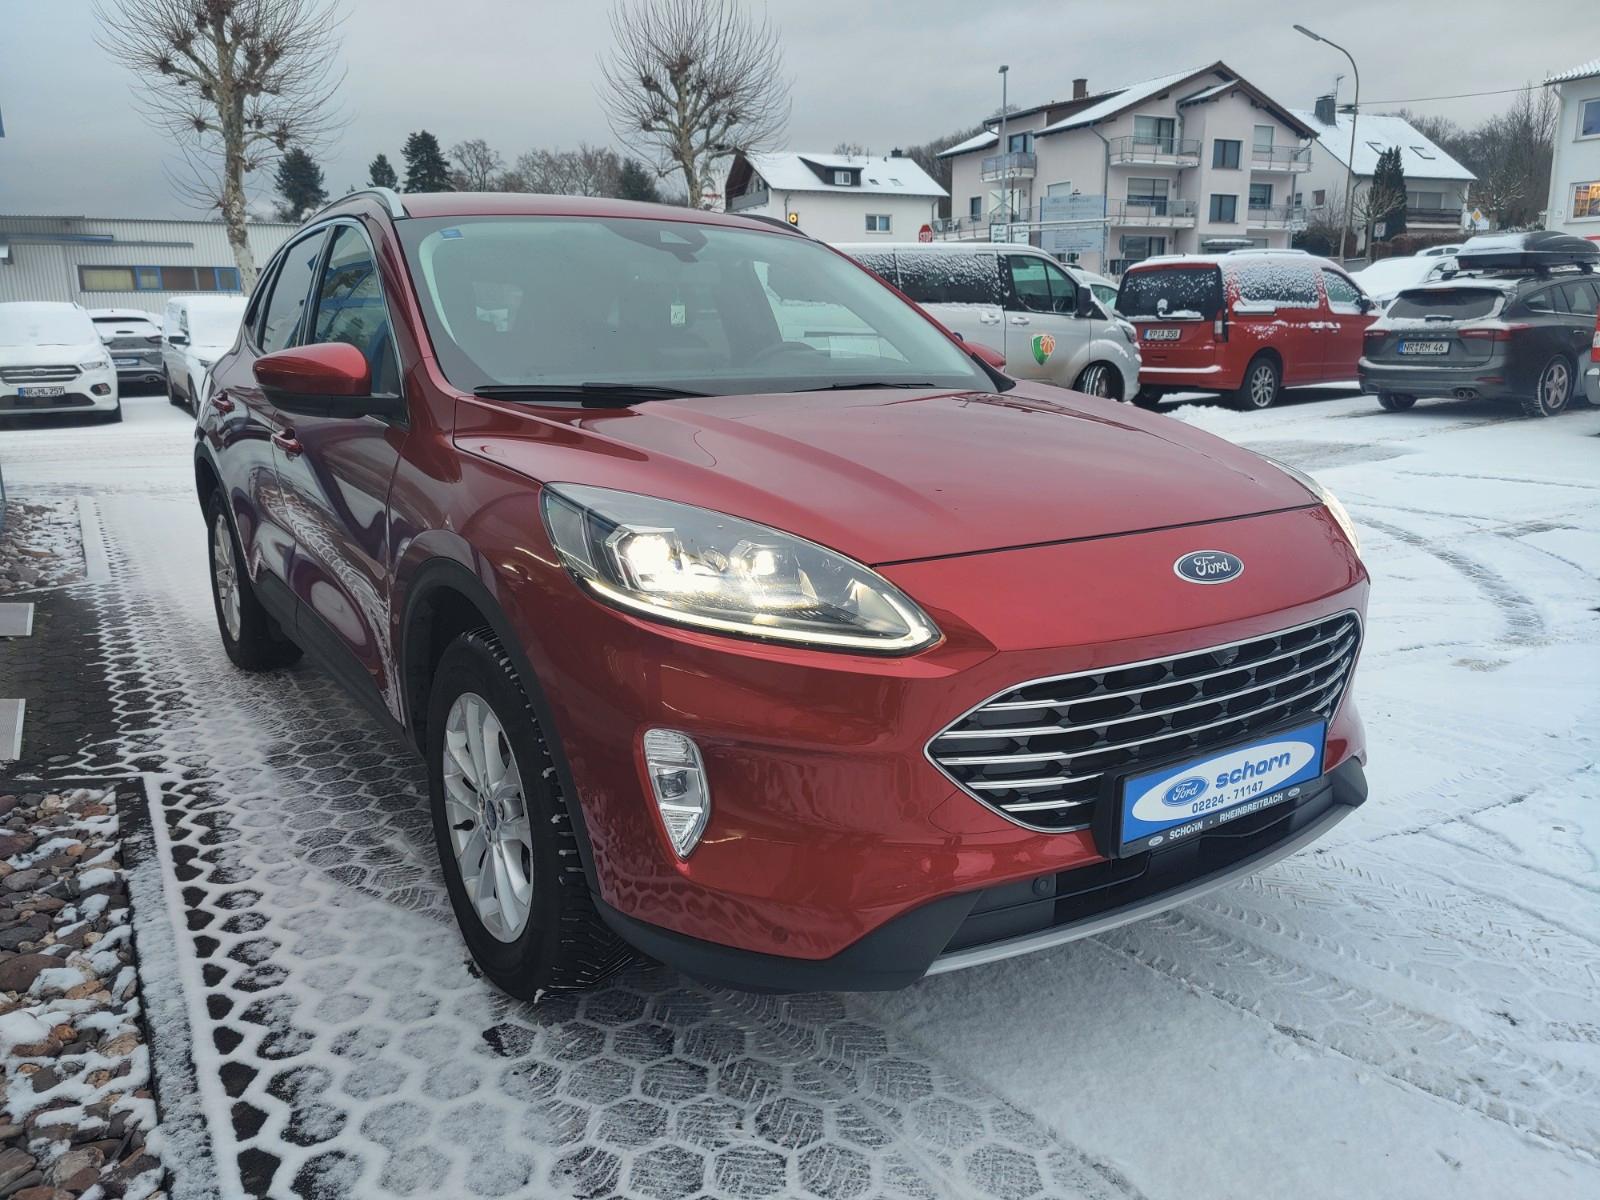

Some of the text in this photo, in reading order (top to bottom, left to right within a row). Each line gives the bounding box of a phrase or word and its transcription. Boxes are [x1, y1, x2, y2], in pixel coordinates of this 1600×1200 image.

[1193, 555, 1231, 576] Ford
[1215, 752, 1291, 790] schorn
[1172, 782, 1199, 801] Ford
[1191, 793, 1225, 814] 02224
[1233, 780, 1264, 801] 71147
[1169, 793, 1283, 840] SCHORN RHEINBREITBACH
